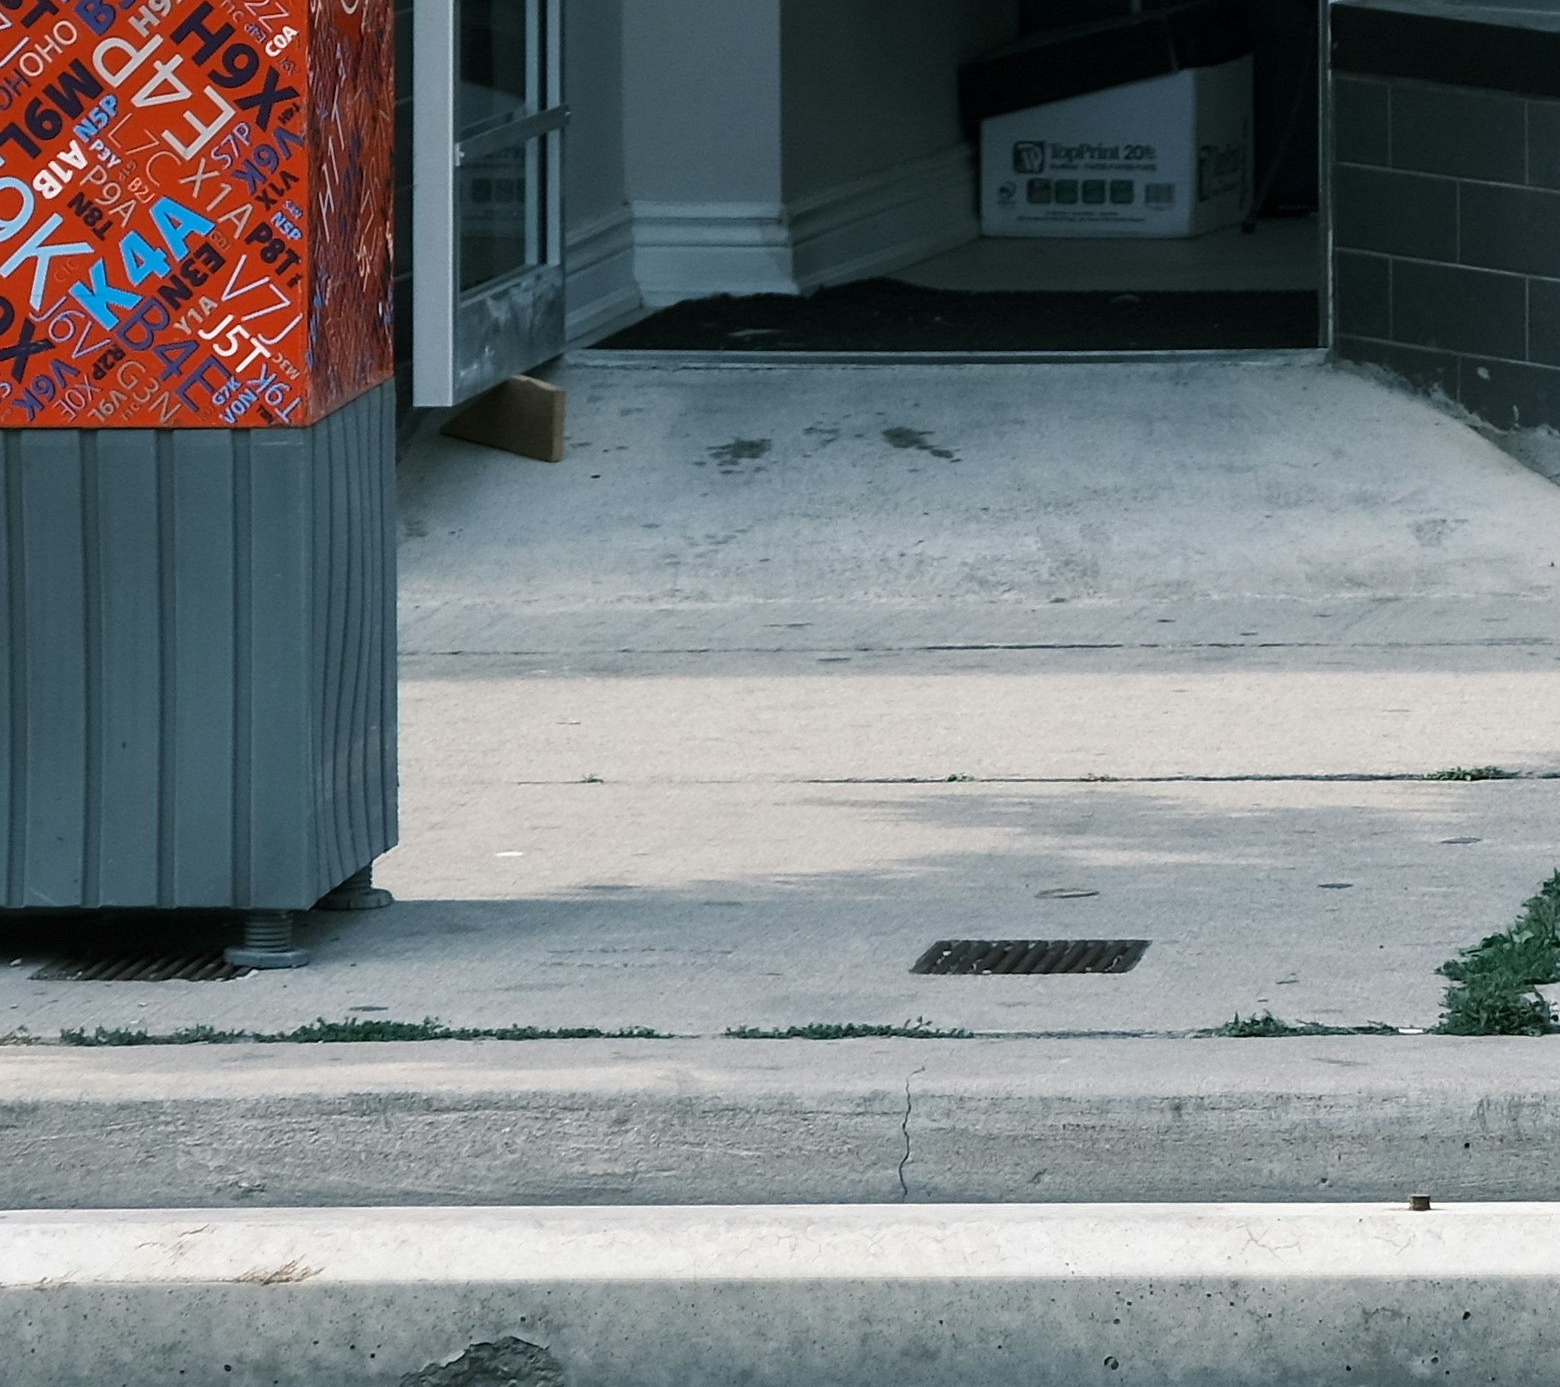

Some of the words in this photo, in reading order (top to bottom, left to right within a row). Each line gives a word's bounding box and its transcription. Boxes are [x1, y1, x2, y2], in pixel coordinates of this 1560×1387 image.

[170, 0, 301, 131] H9X
[73, 93, 119, 143] N5P
[211, 122, 253, 170] S7P
[32, 139, 88, 200] A1B
[1049, 143, 1120, 162] TopPrint
[67, 195, 216, 332] K4A
[245, 221, 302, 277] P8T
[221, 254, 304, 346] V7J
[115, 296, 231, 413] B4E
[197, 314, 271, 374] J5T
